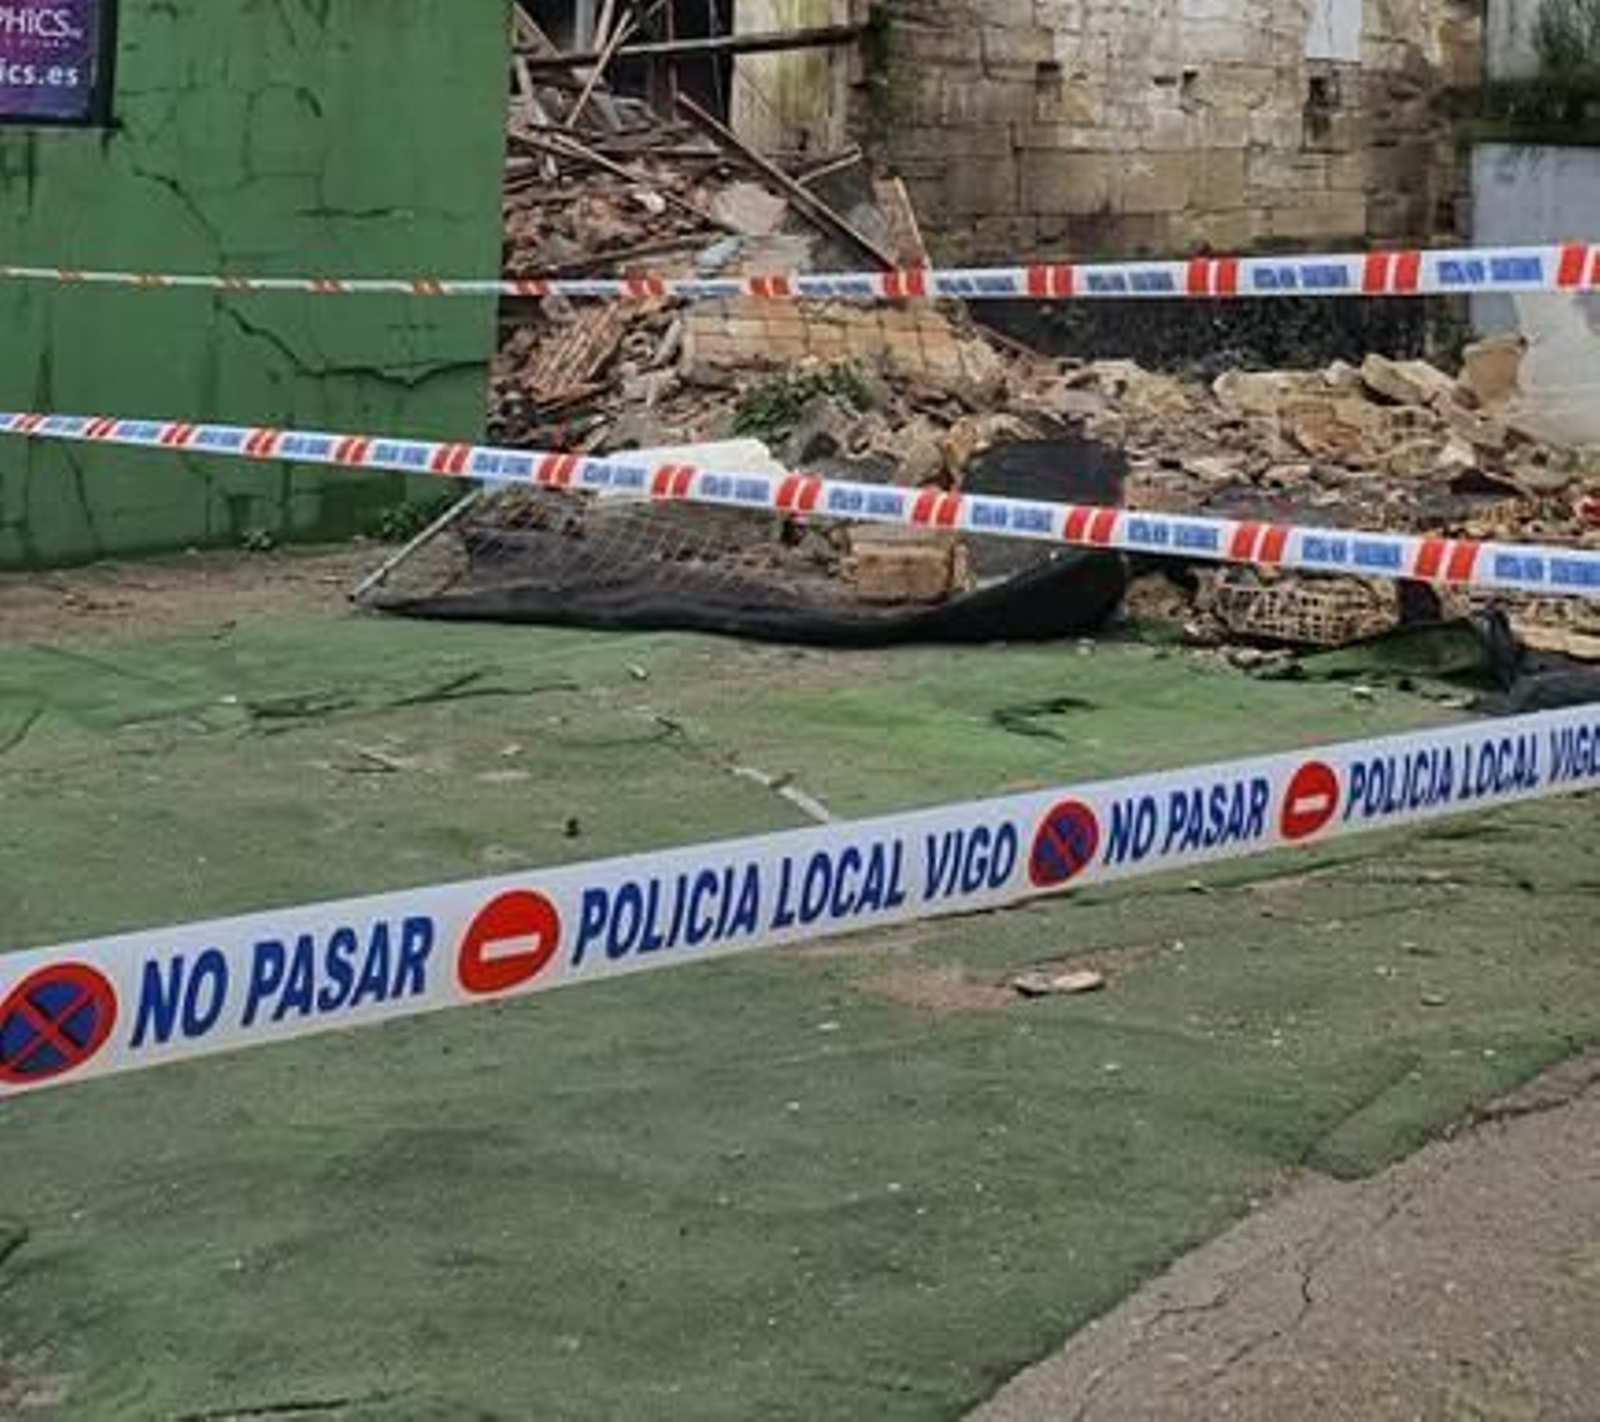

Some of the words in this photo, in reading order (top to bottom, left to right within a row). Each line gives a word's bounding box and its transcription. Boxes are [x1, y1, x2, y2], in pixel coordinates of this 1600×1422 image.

[1103, 795, 1157, 865] NO
[1160, 778, 1269, 855] PASAR
[1343, 746, 1454, 821] POLICIA
[1458, 732, 1540, 799] LOCAL
[571, 861, 760, 966] POLICIA
[770, 839, 905, 929] LOCAL
[922, 821, 1018, 901] VIGO
[130, 948, 230, 1048] NO
[241, 916, 434, 1027] PASAR
